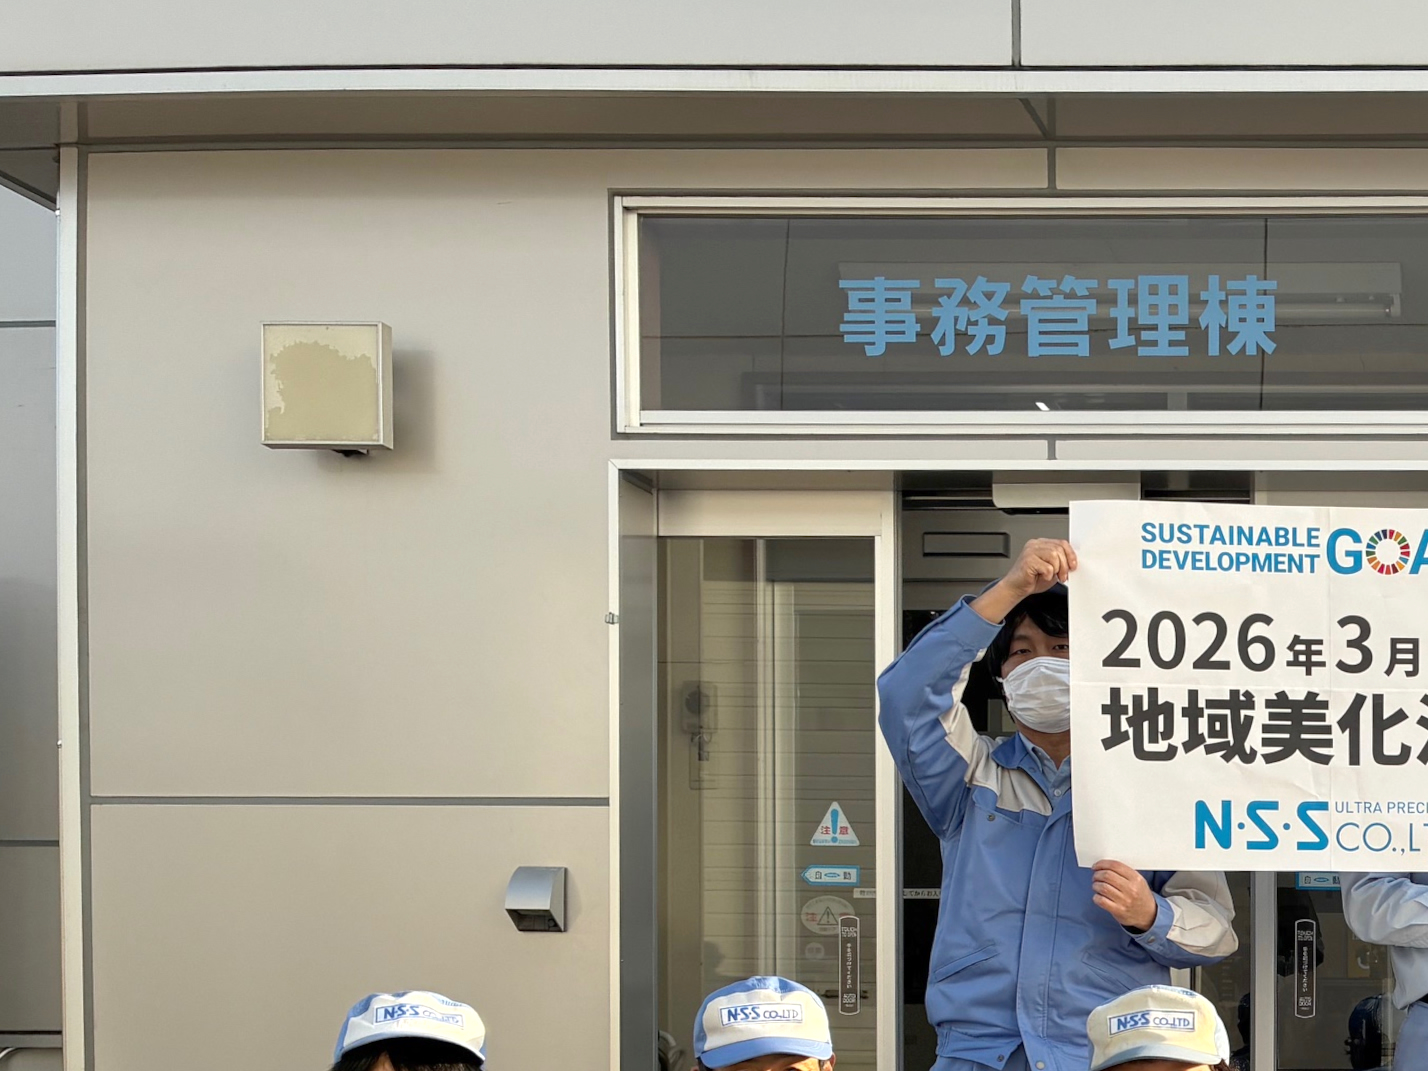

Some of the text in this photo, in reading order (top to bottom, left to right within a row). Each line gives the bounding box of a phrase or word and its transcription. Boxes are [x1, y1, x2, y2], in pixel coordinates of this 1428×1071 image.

[838, 274, 1278, 358] 事務管理棟
[1140, 522, 1321, 548] SUSTAINABLE
[1140, 548, 1321, 574] DEVELOPMENT
[1335, 801, 1384, 815] ULTRA
